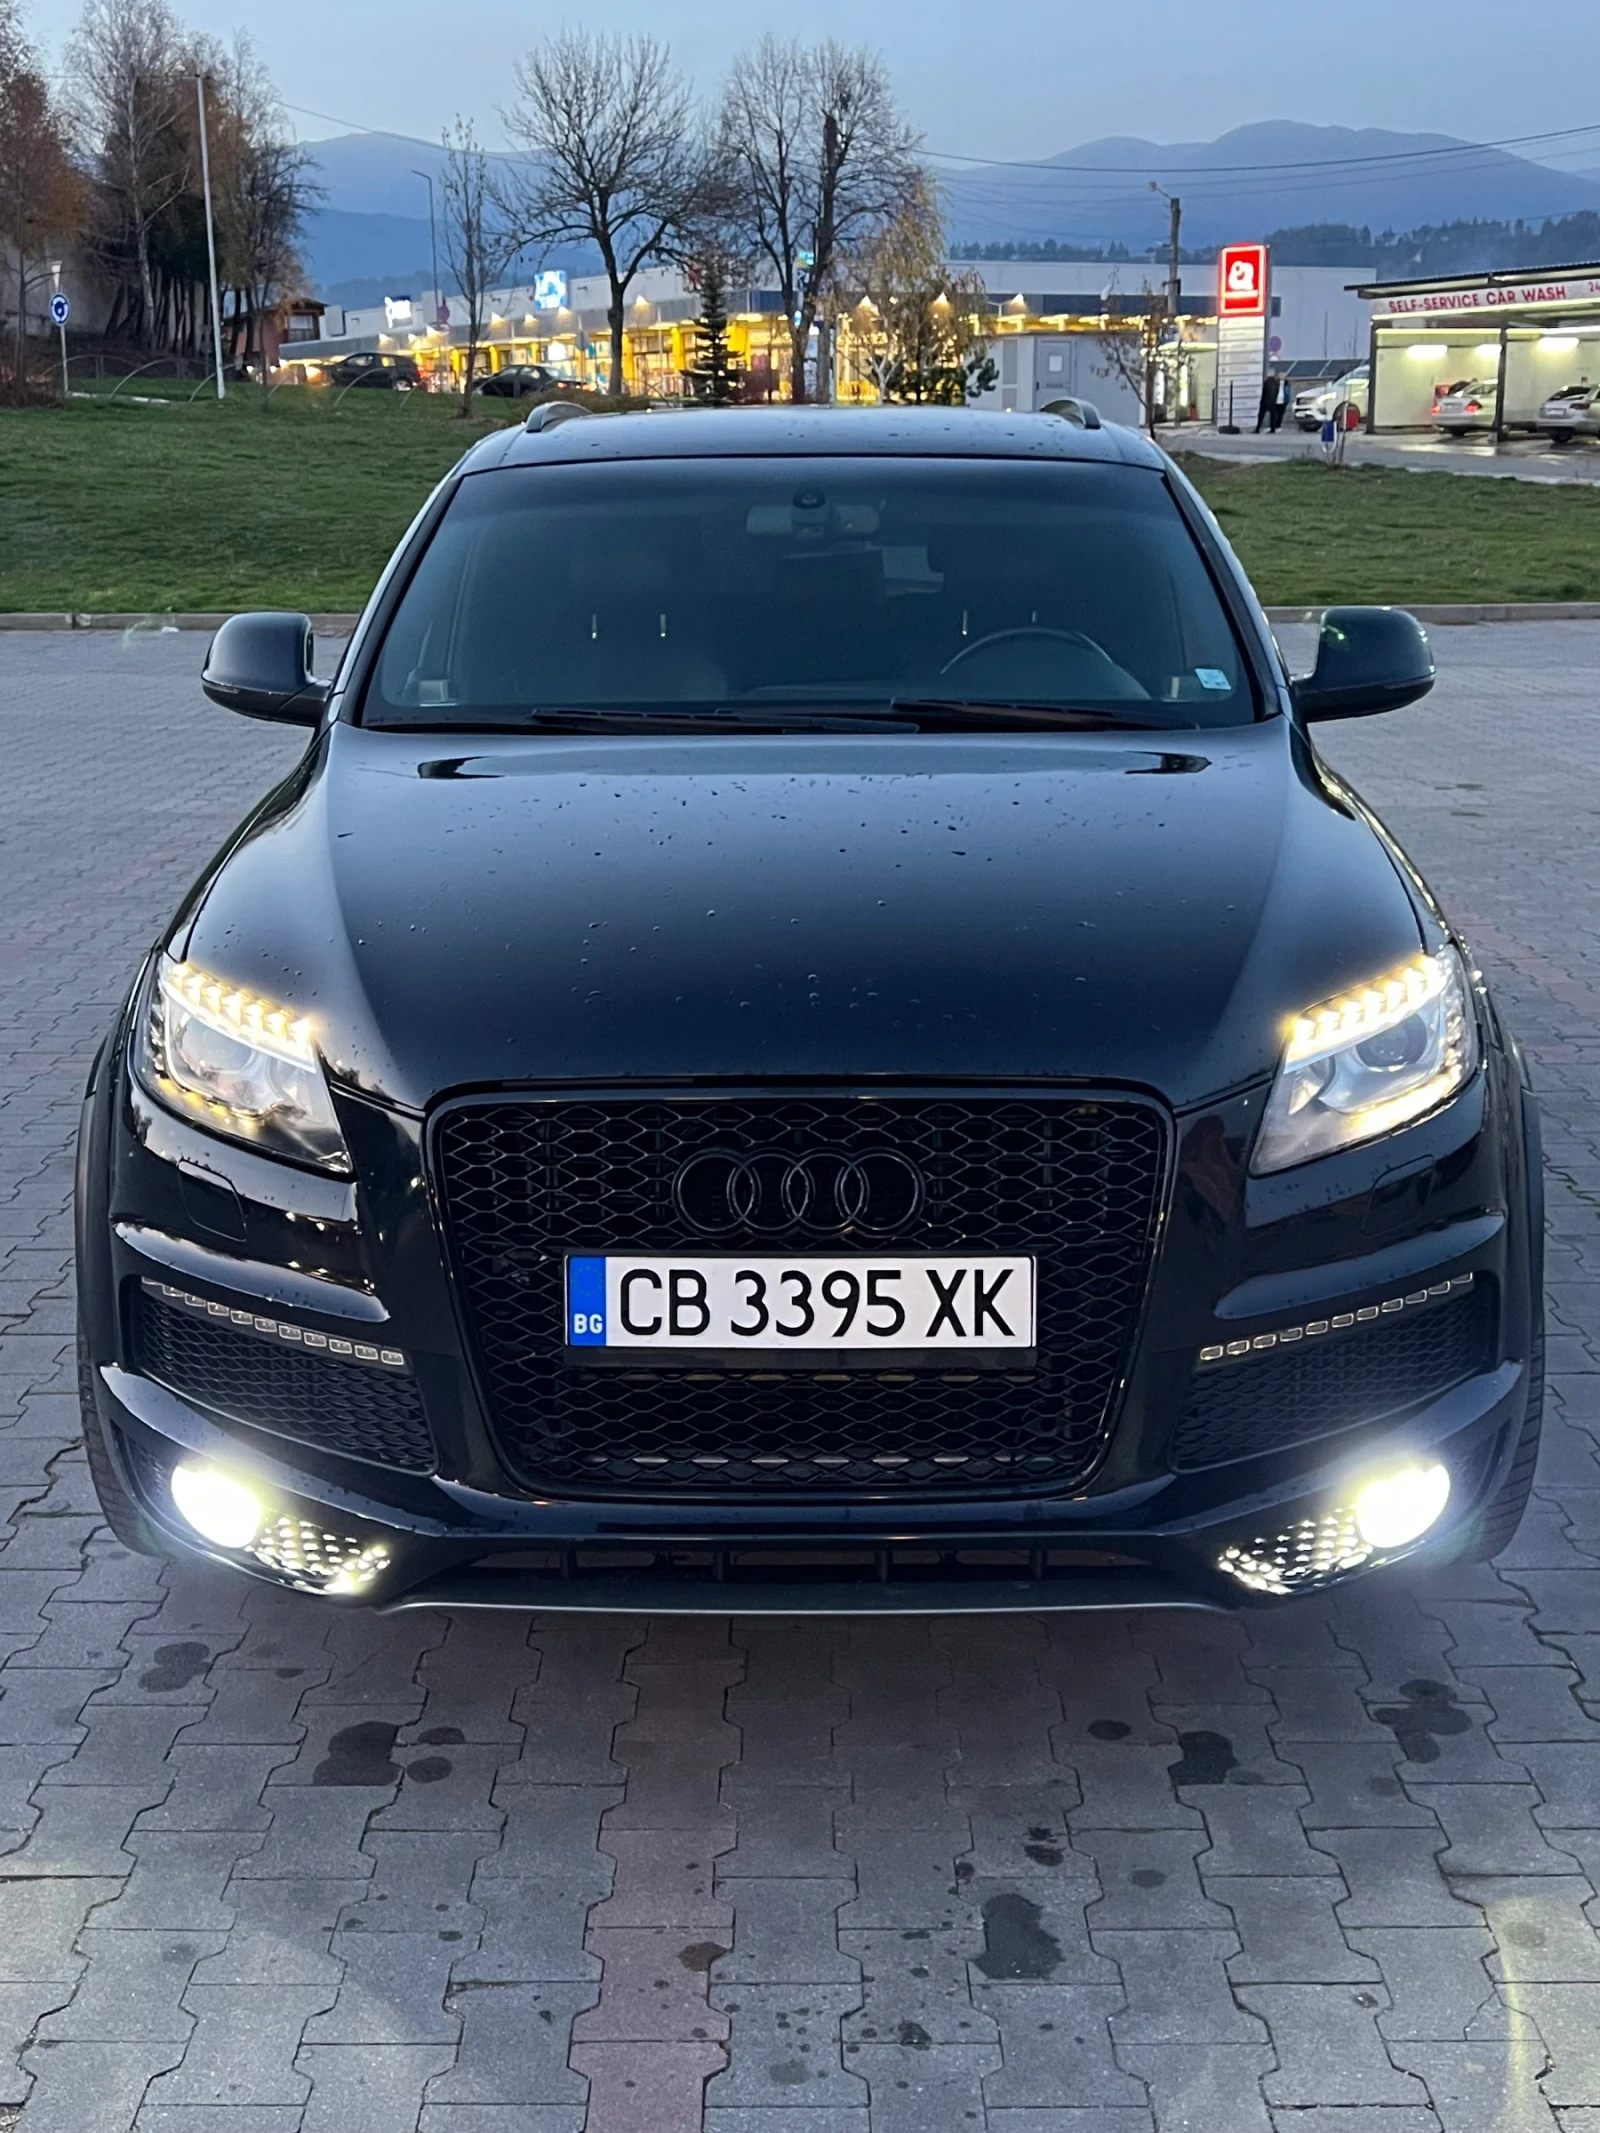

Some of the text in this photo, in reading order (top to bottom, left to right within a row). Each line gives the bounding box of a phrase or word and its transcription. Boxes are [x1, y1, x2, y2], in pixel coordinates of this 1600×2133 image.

[1388, 294, 1479, 313] SELF-SERVICE
[1486, 290, 1516, 305] CAR
[1521, 286, 1566, 302] WASH
[573, 1268, 1016, 1338] BG CB 3395 XK
